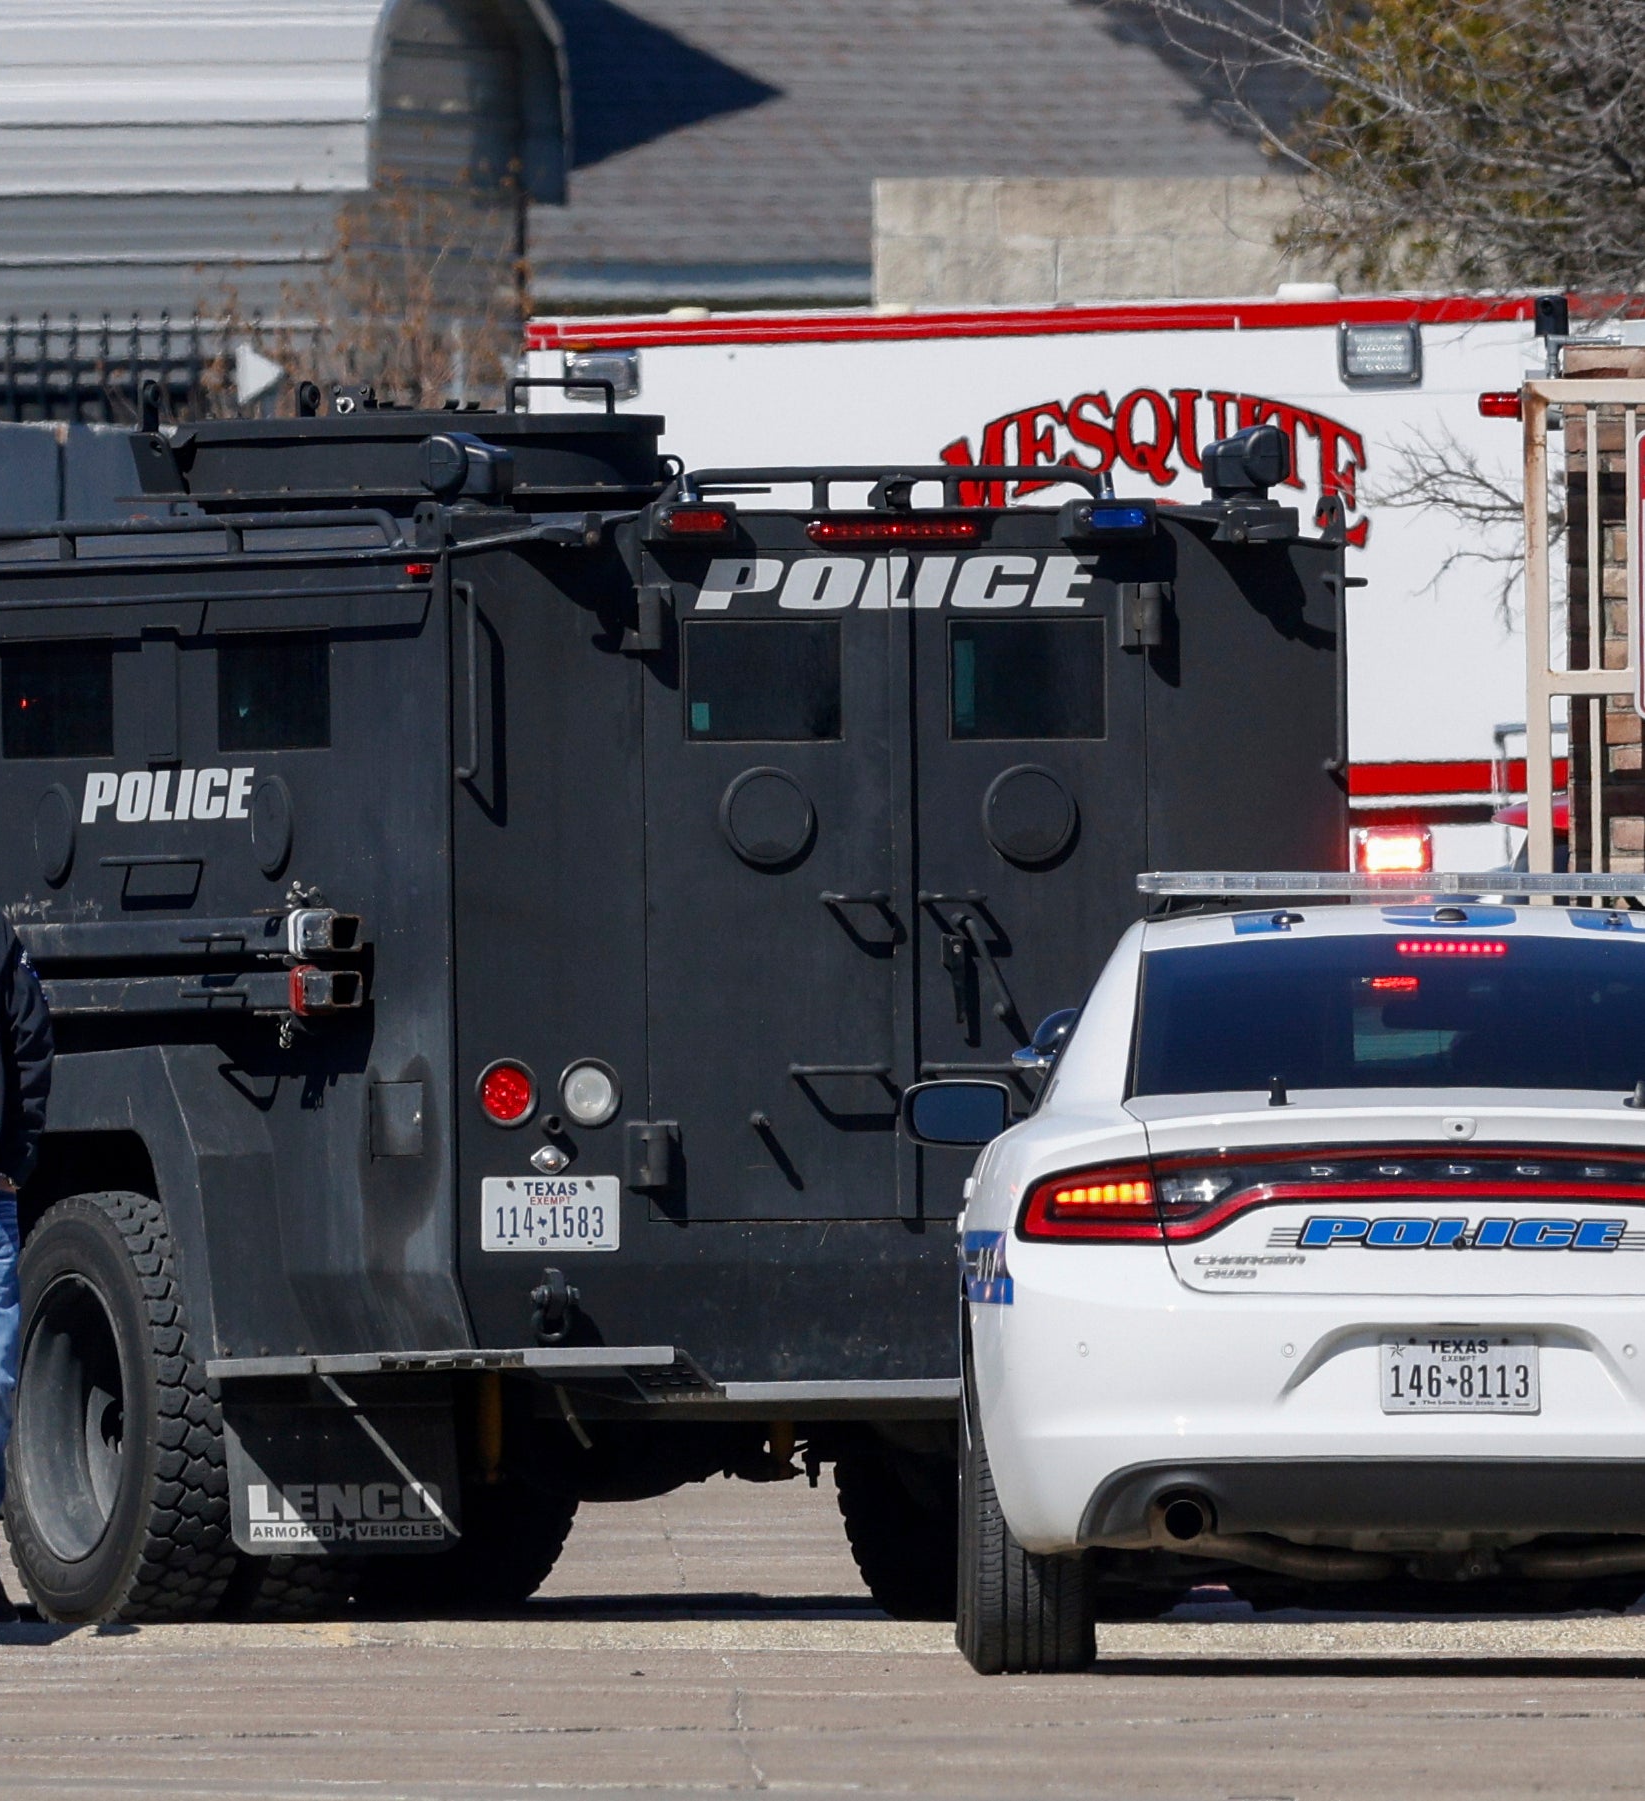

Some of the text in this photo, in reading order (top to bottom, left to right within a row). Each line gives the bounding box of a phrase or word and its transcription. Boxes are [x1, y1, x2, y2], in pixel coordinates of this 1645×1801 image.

[694, 555, 1101, 610] POLICE
[81, 767, 255, 824] POLICE
[524, 1182, 578, 1196] TEXAS
[530, 1197, 572, 1206] EXEMPT
[496, 1206, 604, 1239] 114 1583
[1296, 1217, 1628, 1251] POLICE
[1428, 1339, 1489, 1355] TEXAS
[1390, 1364, 1530, 1398] 146 8113
[248, 1484, 443, 1521] LENCO
[252, 1523, 443, 1538] ARMORED VEHICLES
